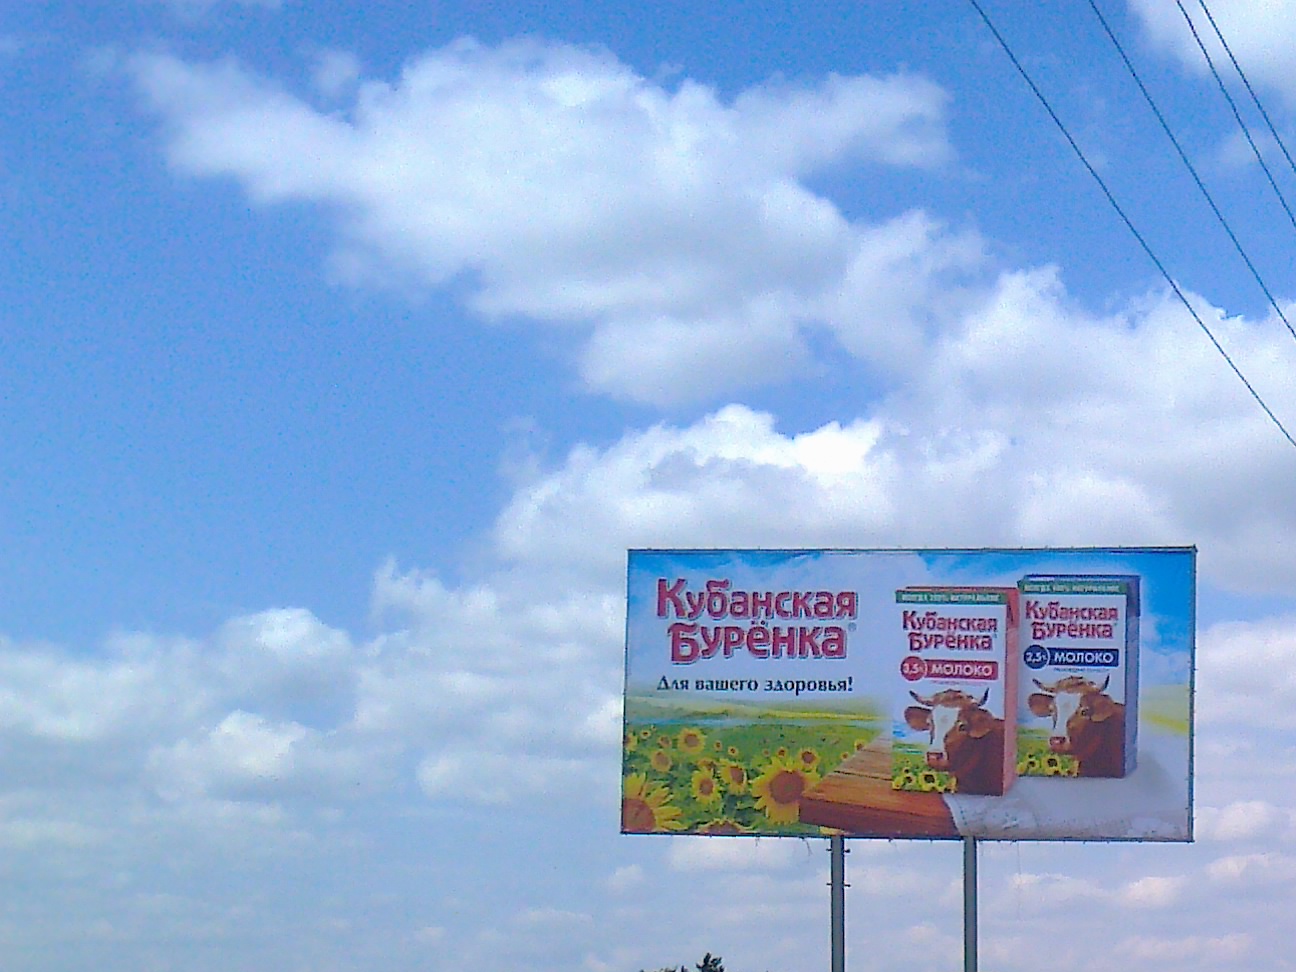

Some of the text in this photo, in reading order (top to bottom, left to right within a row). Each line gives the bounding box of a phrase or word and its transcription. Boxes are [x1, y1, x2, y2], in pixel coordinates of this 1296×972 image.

[657, 578, 858, 620] Кубанская
[902, 610, 998, 632] Кубанская
[1025, 600, 1118, 621] Кубанская
[667, 620, 848, 665] Бурёнка
[1054, 651, 1114, 664] МОЛОКО
[931, 664, 993, 676] МОЛОКО
[657, 676, 853, 695] Для вашего здоровья!
